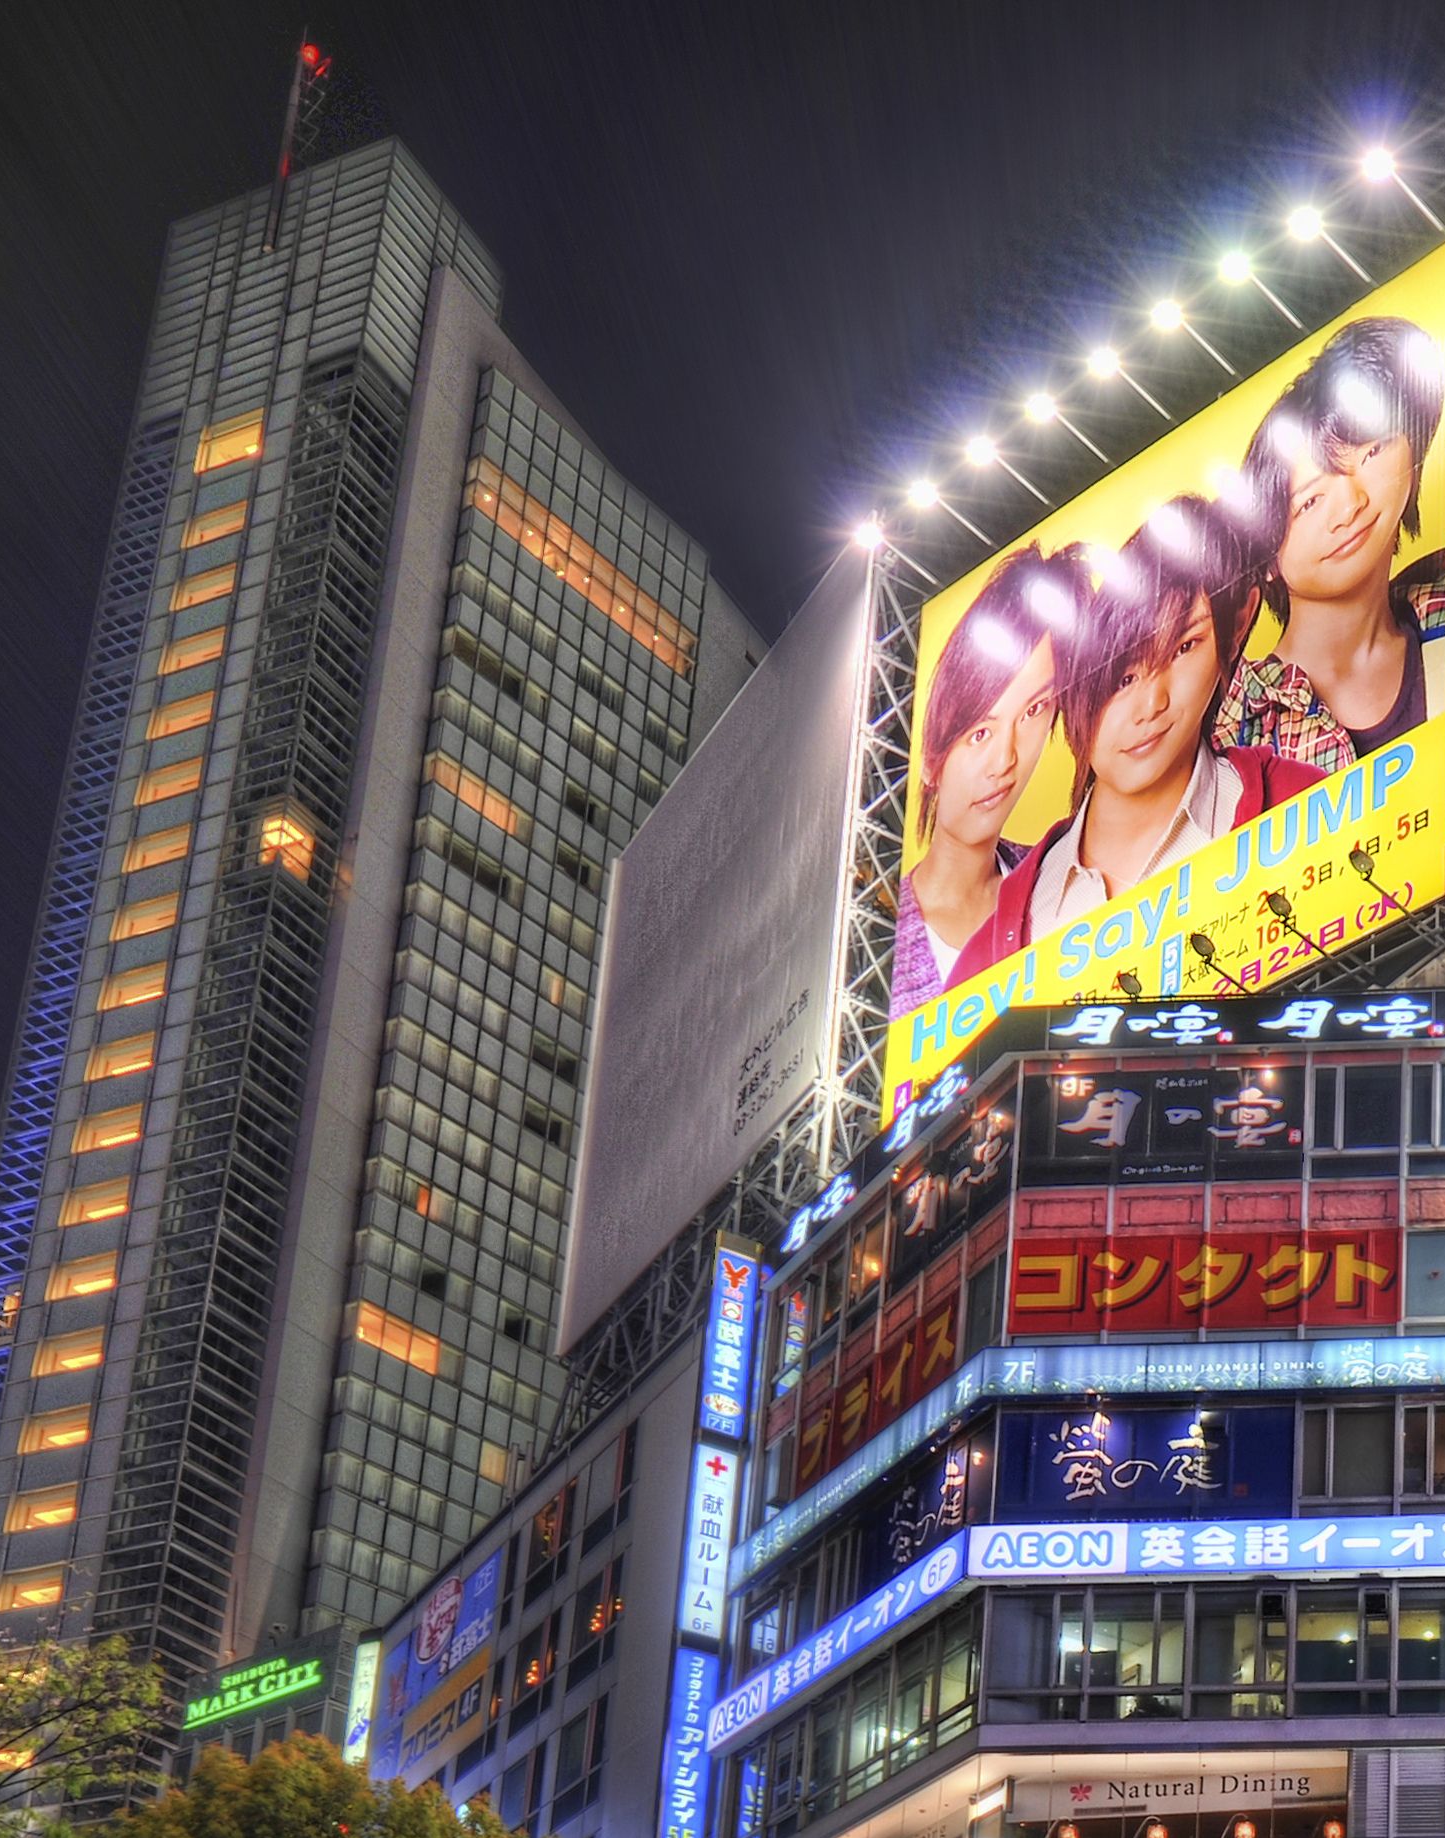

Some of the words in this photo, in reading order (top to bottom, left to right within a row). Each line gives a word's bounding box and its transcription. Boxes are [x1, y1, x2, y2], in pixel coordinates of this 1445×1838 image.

[910, 951, 1037, 1064] Hey!
[1059, 863, 1191, 978] Say!
[1215, 743, 1415, 892] JUMP
[1050, 1003, 1221, 1045] 月の宴
[1258, 996, 1431, 1040] 月の宴
[1060, 1076, 1096, 1096] 9F
[1057, 1087, 1288, 1149] 月の宴
[1015, 1243, 1392, 1308] コンタクト
[713, 1320, 744, 1391] 武富士
[1003, 1361, 1036, 1383] 7F
[1273, 1359, 1326, 1372] DINING
[800, 1306, 956, 1480] プライス
[694, 1493, 724, 1612] 献血ルーム
[984, 1531, 1112, 1567] AEON
[692, 1617, 713, 1632] 6F
[712, 1683, 764, 1742] AEON
[773, 1578, 915, 1703] 英会話イーオン
[926, 1556, 950, 1588] 6F
[187, 1682, 256, 1721] MARK
[258, 1659, 321, 1694] CITY
[220, 1657, 288, 1690] SHIBUYA
[461, 1681, 480, 1718] 4F
[1107, 1778, 1205, 1801] Natural
[1219, 1772, 1311, 1796] Dining
